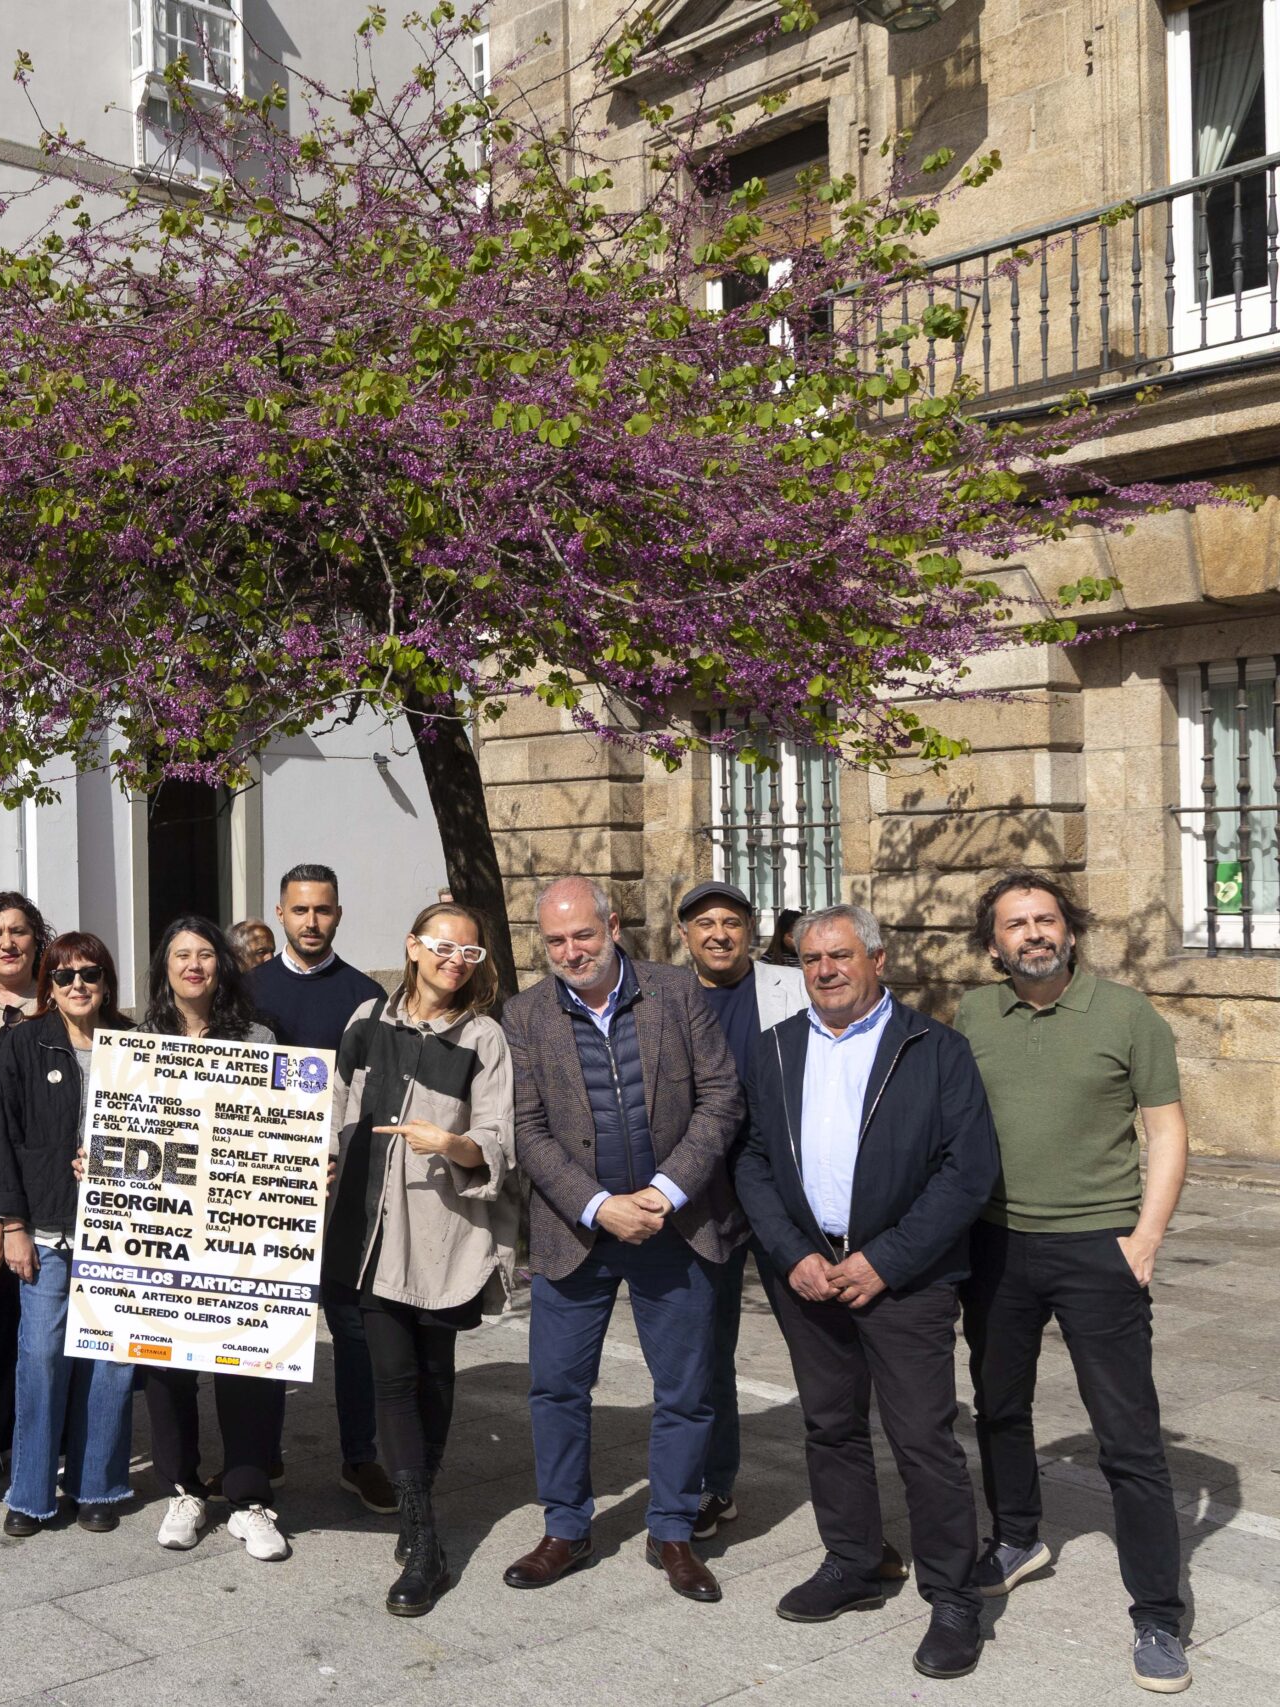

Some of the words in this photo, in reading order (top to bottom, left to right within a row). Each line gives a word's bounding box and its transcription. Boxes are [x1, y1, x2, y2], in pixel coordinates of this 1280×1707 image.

[99, 1035, 112, 1046] IX
[119, 1037, 156, 1049] CICLO
[161, 1041, 269, 1060] METROPOLITANO
[133, 1052, 150, 1062] DE
[155, 1053, 204, 1067] MÚSICA
[210, 1059, 219, 1069] E
[225, 1060, 268, 1073] ARTES
[280, 1057, 305, 1067] ELAS
[154, 1067, 188, 1080] POLA
[194, 1071, 267, 1087] IGUALDADE
[280, 1068, 302, 1077] SON
[280, 1078, 328, 1089] ARTISTAS
[95, 1090, 143, 1103] BRANCA
[149, 1095, 182, 1107] TRIGO
[94, 1099, 102, 1108] E
[107, 1100, 158, 1113] OCTAVIA
[163, 1106, 201, 1117] RUSSO
[215, 1102, 261, 1116] MARTA
[267, 1107, 325, 1121] IGLESIAS
[93, 1113, 140, 1125] CARLOTA
[145, 1118, 199, 1131] MOSQUERA
[214, 1112, 250, 1121] SEMPRE
[253, 1116, 287, 1125] ARRIBA
[92, 1121, 99, 1129] E
[103, 1122, 122, 1131] SOL
[127, 1122, 174, 1136] ÁLVAREZ
[212, 1126, 254, 1138] ROSALIE
[258, 1131, 323, 1144] CUNNINGHAM
[212, 1135, 231, 1144] (U.K.)
[87, 1134, 199, 1186] EDE
[210, 1147, 268, 1162] SCARLET
[273, 1153, 320, 1167] RIVERA
[210, 1158, 235, 1168] (U.S.A.)
[251, 1162, 281, 1171] GARUFA
[283, 1165, 302, 1173] CLUB
[87, 1177, 126, 1187] TEATRO
[129, 1181, 162, 1191] COLÓN
[209, 1171, 246, 1184] SOFÍA
[252, 1175, 318, 1191] ESPIÑEIRA
[86, 1190, 193, 1216] GEORGINA
[207, 1196, 232, 1206] (U.S.A.)
[208, 1187, 252, 1200] STACY
[258, 1192, 318, 1207] ANTONEL
[84, 1205, 132, 1219] (VENEZUELA)
[207, 1209, 316, 1233] TCHOTCHKE
[83, 1218, 123, 1231] GOSIA
[130, 1222, 193, 1238] TREBACZ
[205, 1223, 231, 1233] (U.S.A.)
[81, 1233, 112, 1254] LA
[124, 1238, 190, 1261] OTRA
[204, 1238, 257, 1256] XULIA
[263, 1243, 315, 1262] PISÓN
[78, 1263, 174, 1286] CONCELLOS
[180, 1273, 312, 1300] PARTICIPANTES
[75, 1284, 84, 1293] A
[89, 1285, 136, 1299] CORUÑA
[142, 1291, 192, 1304] ARTEIXO
[197, 1296, 259, 1311] BETANZOS
[264, 1304, 312, 1317] CARRAL
[114, 1304, 179, 1319] CULLEREDO
[184, 1311, 232, 1325] OLEIROS
[237, 1317, 269, 1329] SADA
[79, 1327, 113, 1337] PRODUCE
[130, 1333, 173, 1344] PATROCINA
[222, 1343, 269, 1354] COLABORAN
